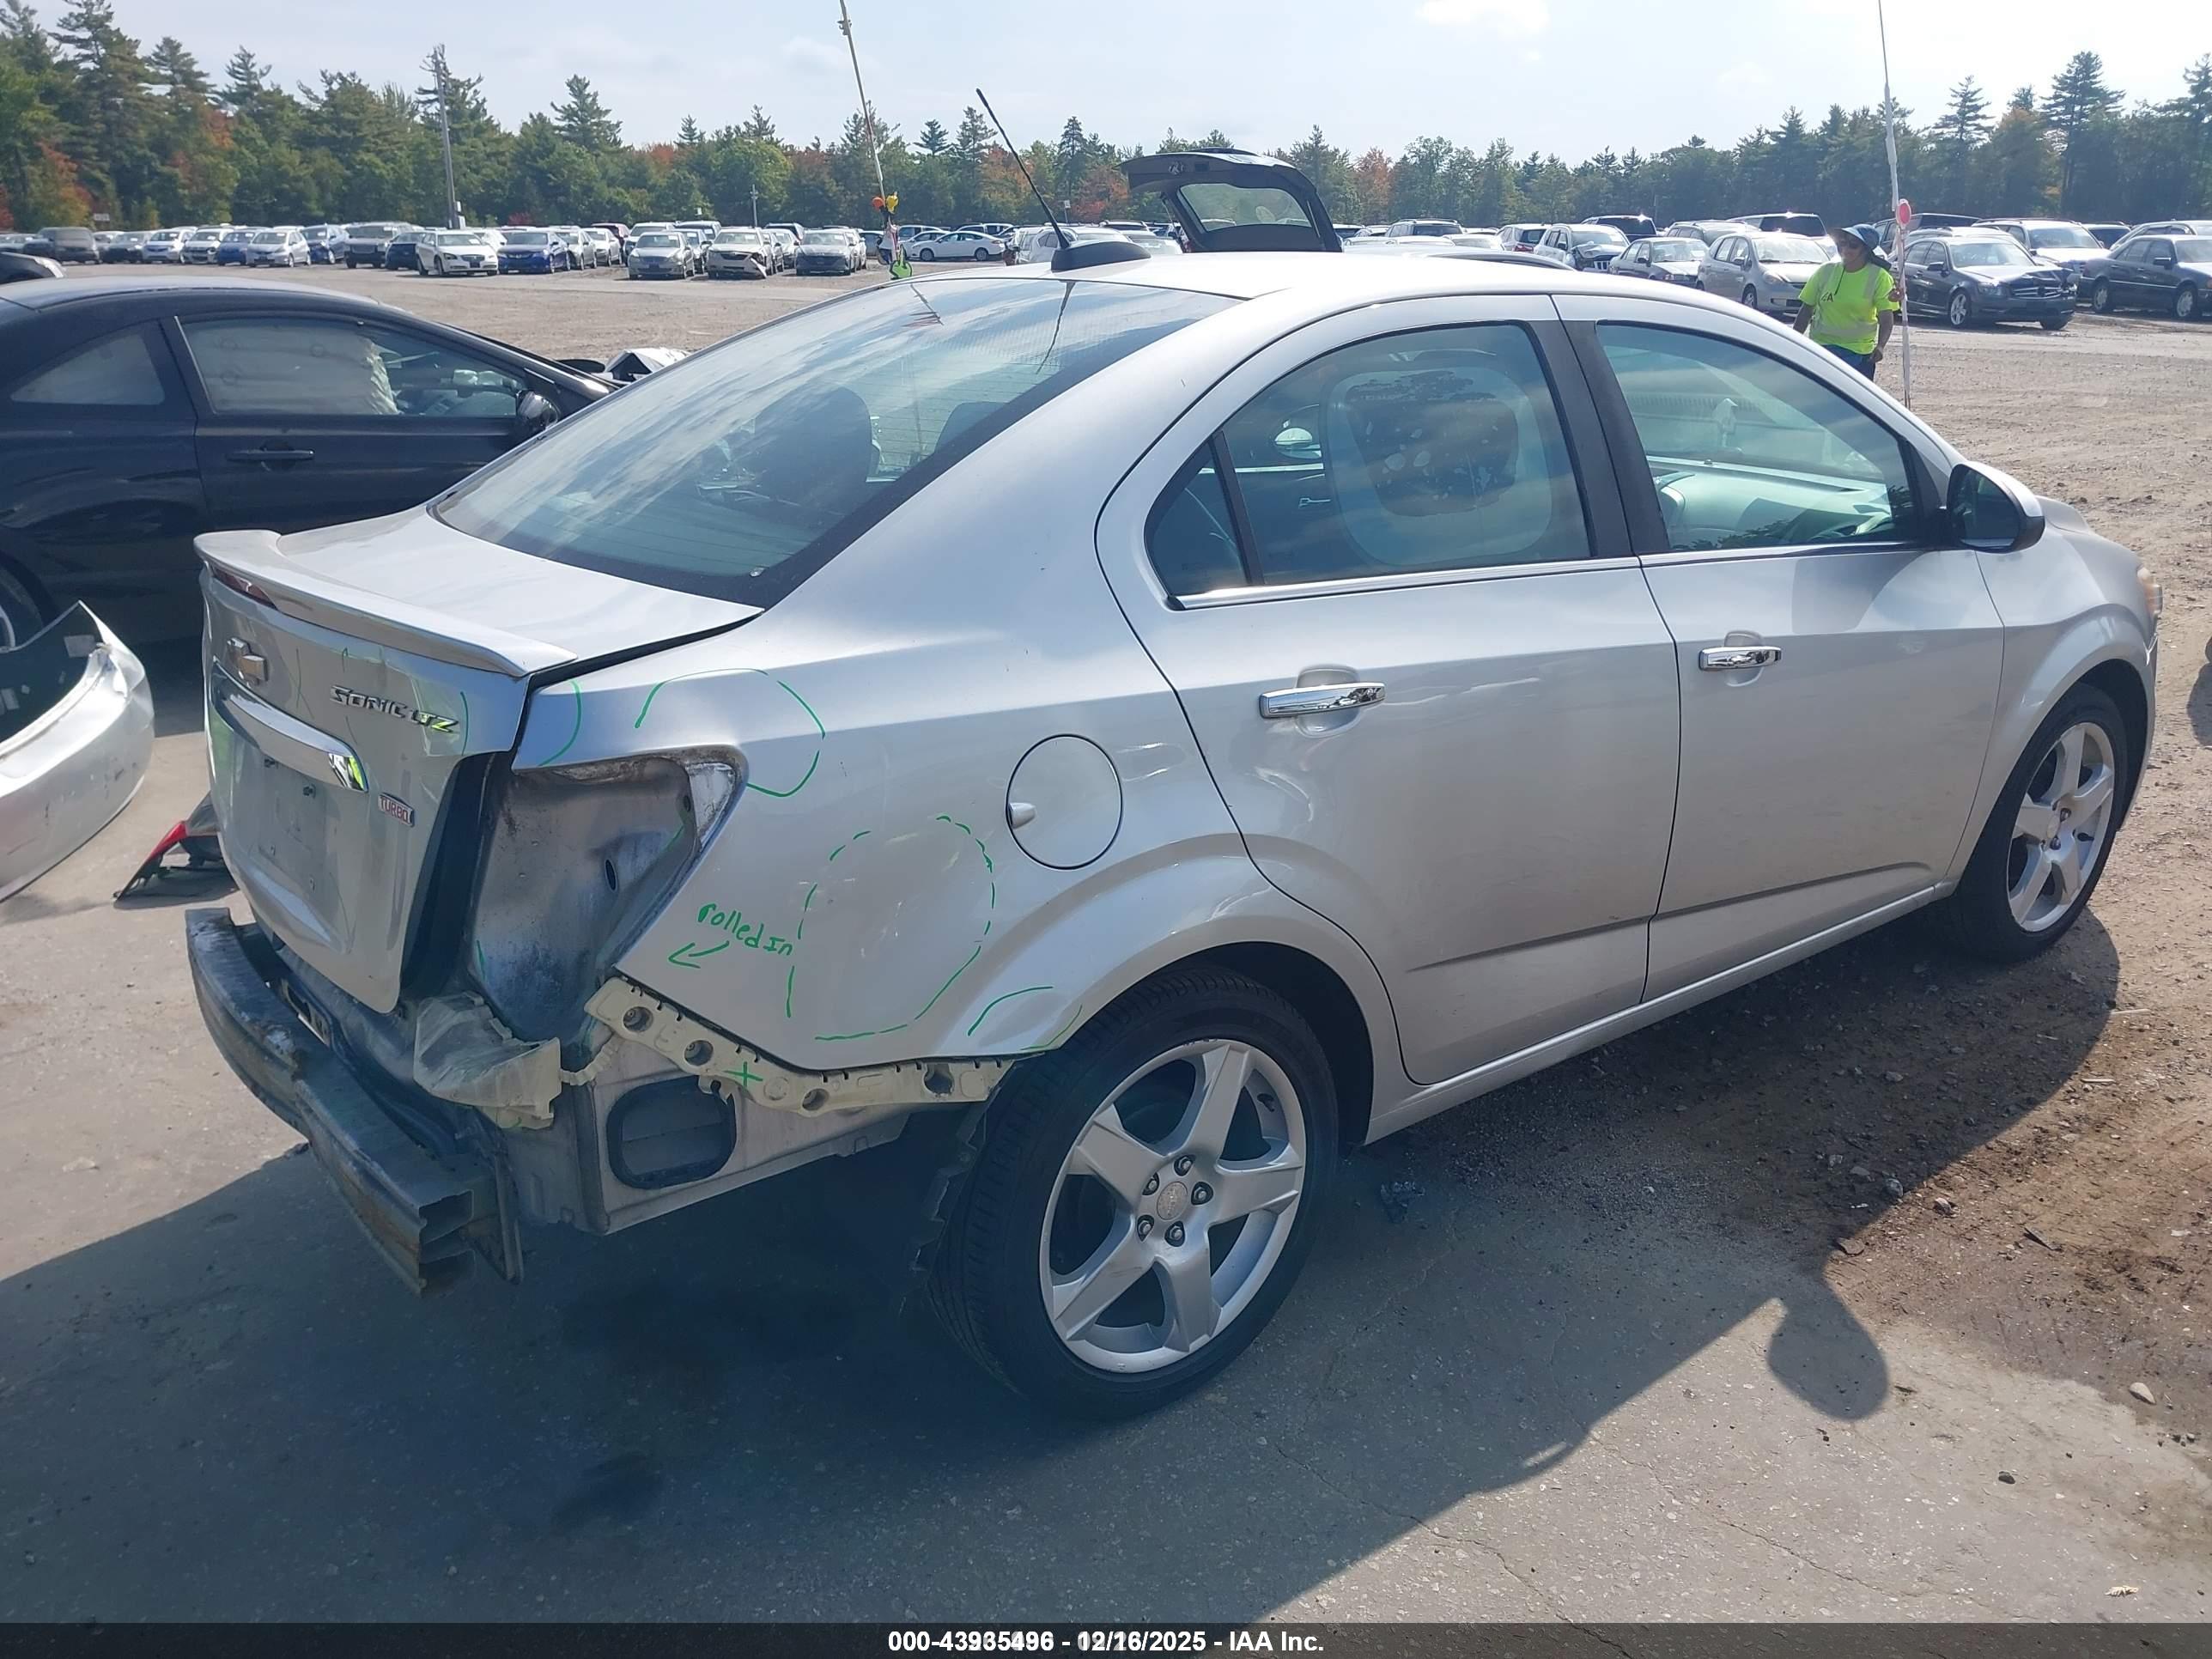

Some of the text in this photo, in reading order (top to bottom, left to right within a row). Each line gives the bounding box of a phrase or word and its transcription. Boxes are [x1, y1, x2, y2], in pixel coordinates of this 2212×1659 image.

[330, 685, 459, 733] SONIC LTZ
[380, 796, 408, 823] TURBO
[697, 902, 765, 949] rolled
